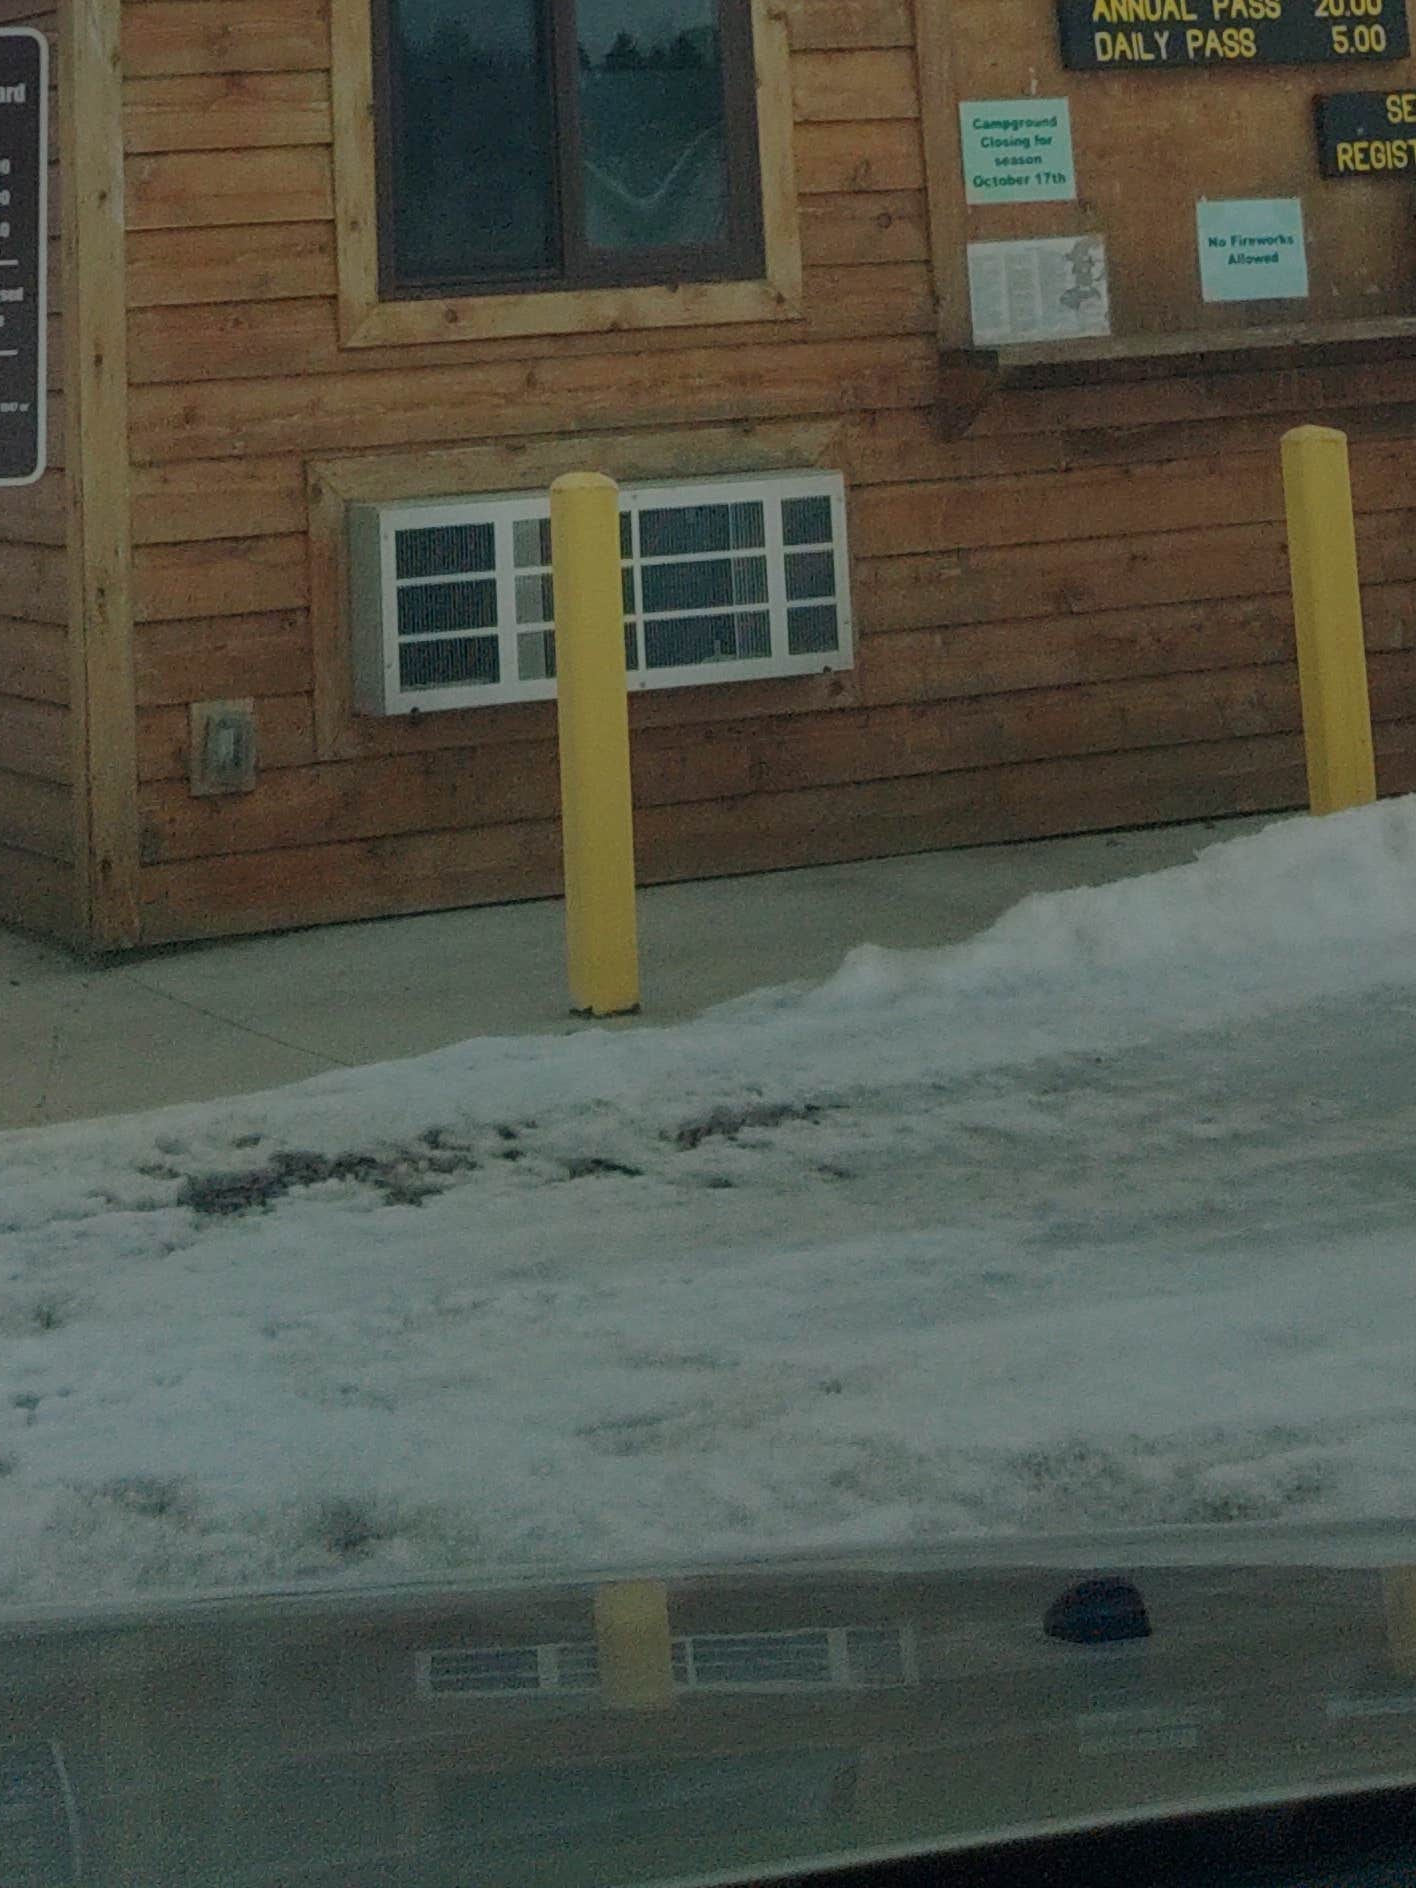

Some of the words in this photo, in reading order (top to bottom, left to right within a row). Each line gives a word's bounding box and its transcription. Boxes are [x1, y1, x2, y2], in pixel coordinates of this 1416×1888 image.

[1094, 30, 1170, 62] DAILY
[1185, 27, 1257, 59] PASS
[1331, 23, 1387, 54] 5.00
[972, 115, 1058, 132] Campground
[980, 136, 1031, 150] Closing
[1034, 134, 1053, 146] for
[994, 155, 1043, 167] season
[972, 174, 1030, 188] October
[1034, 171, 1067, 185] 17th
[1207, 237, 1227, 248] No
[1230, 234, 1294, 247] Fireworks
[1227, 251, 1280, 265] Allowed
